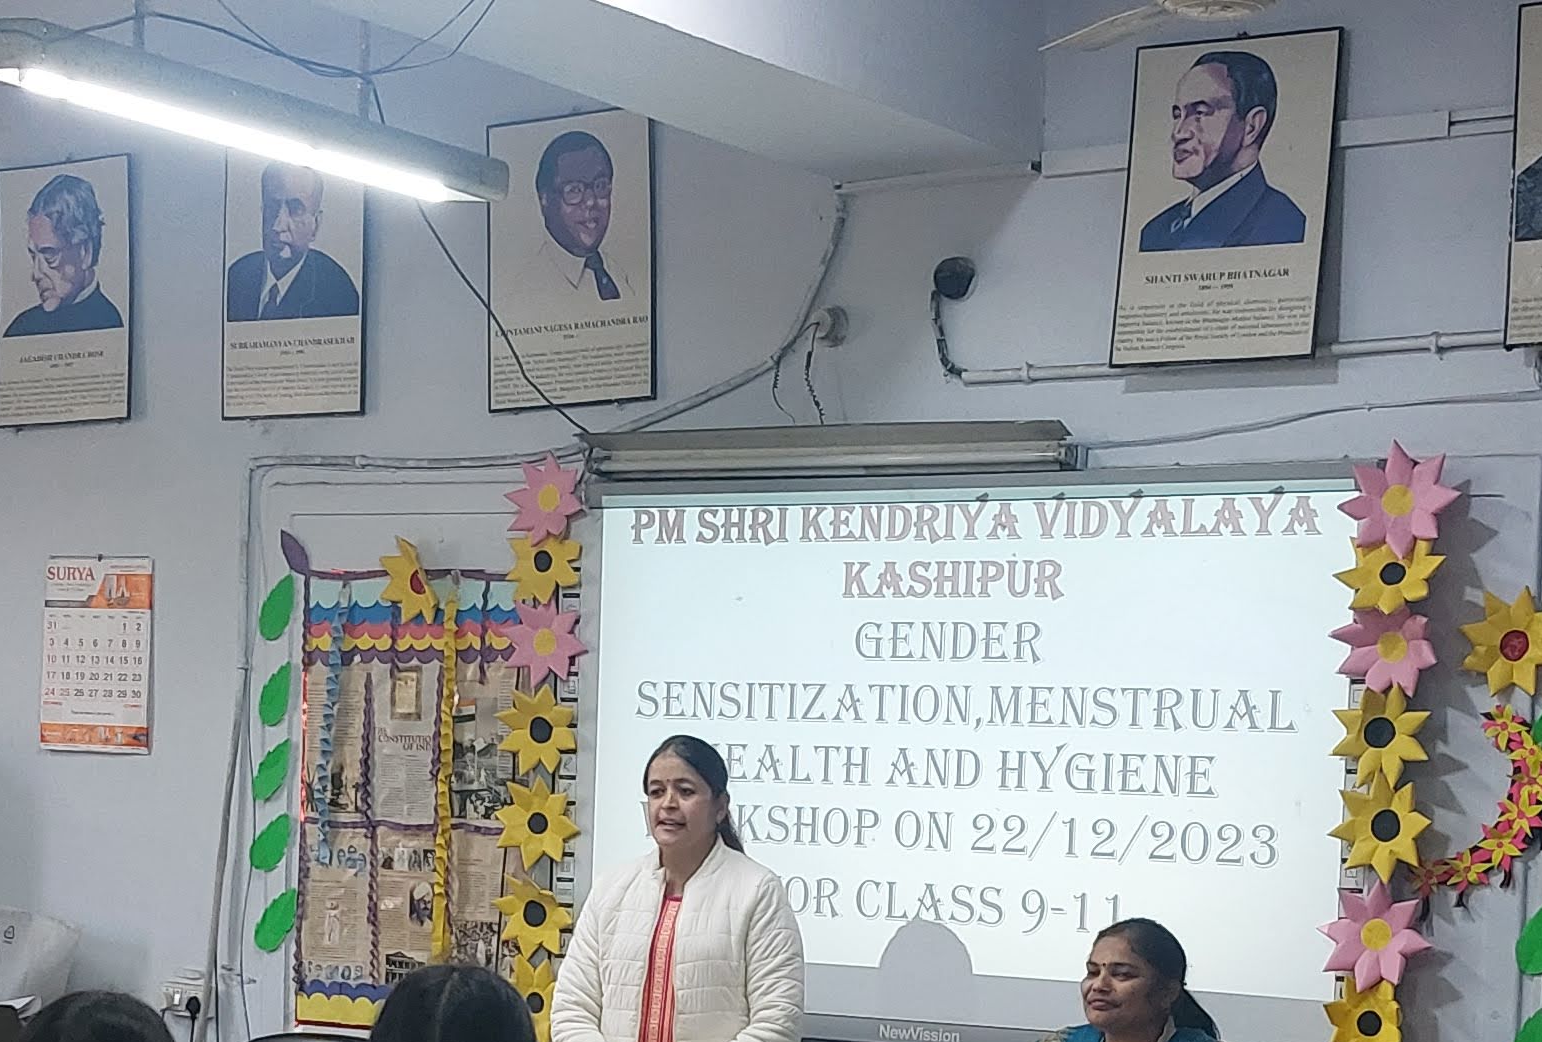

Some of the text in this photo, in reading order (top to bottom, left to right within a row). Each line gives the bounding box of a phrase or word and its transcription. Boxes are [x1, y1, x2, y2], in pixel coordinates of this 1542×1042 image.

[1145, 268, 1290, 285] SHANTI SWARUP BHATNAGAR
[631, 487, 1324, 547] PM SHRI KENDRIYA VIDYALAYA
[46, 566, 96, 581] SURYA
[842, 560, 1065, 600] KASHIPUR
[123, 622, 127, 630] 1
[136, 623, 141, 632] 2
[49, 638, 141, 648] 3 4 5 6 7 8 9
[855, 621, 1043, 664] GENDER
[47, 655, 143, 665] 10 11 12 13 14 15 16
[47, 671, 56, 680] 17
[61, 672, 71, 680] 18
[75, 672, 85, 680] 19
[89, 672, 99, 680] 20
[118, 673, 128, 682] 22
[132, 674, 142, 682] 23
[45, 688, 55, 696] 24
[88, 689, 99, 698] 27
[131, 690, 141, 698] 30
[635, 681, 1299, 733] SENSITIZATION,MENSTRUAL
[714, 743, 1219, 797] EALTH AND HYGIENE
[894, 810, 956, 852] ON
[970, 811, 1279, 868] 22/12/2023
[778, 875, 1122, 935] OR CLASS 9-11
